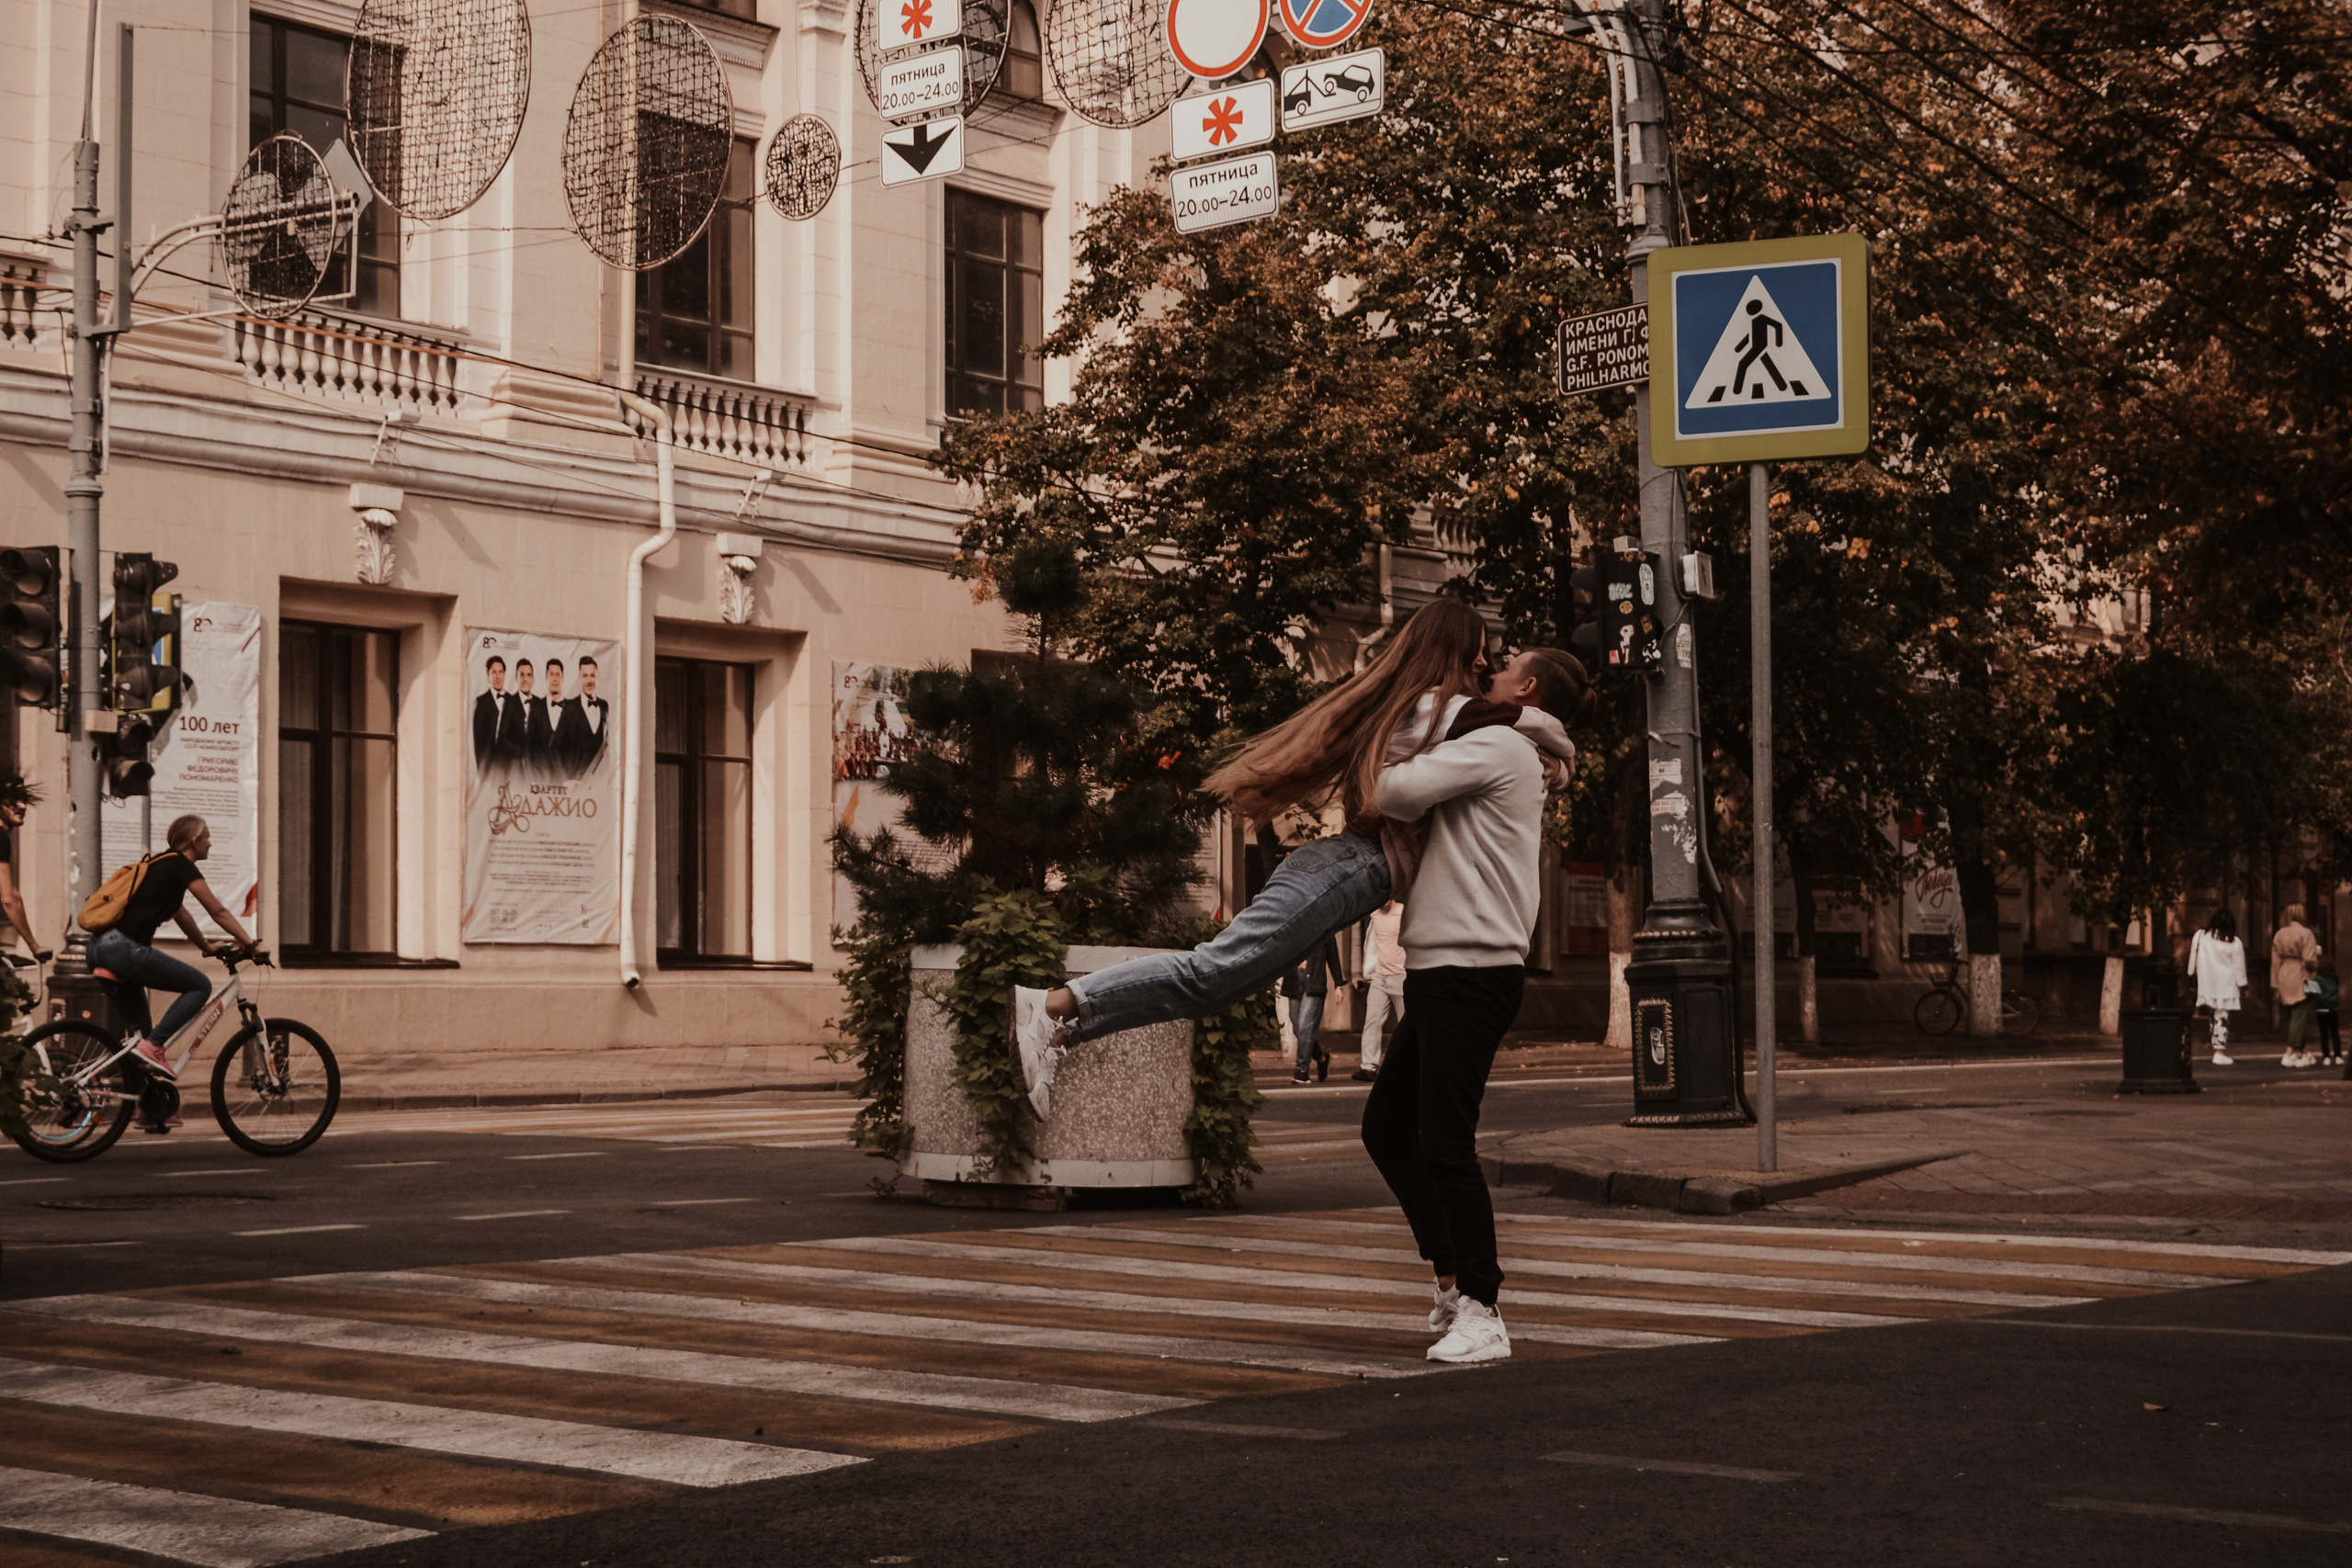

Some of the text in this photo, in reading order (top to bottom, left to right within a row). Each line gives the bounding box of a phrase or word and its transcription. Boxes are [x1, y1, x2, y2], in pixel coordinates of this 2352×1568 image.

[891, 62, 945, 86] пятница
[1189, 163, 1259, 189] пятница
[1566, 308, 1647, 338] КРАСНОДА
[1566, 331, 1617, 355] ИМЕНИ
[1566, 343, 1649, 373] G.F. PONOM
[1566, 360, 1650, 390] PHILHARMO
[179, 716, 241, 735] 100 лет
[198, 756, 239, 766] ГРИГОРИЮ
[179, 773, 239, 784] ПОНОМАРЕНКО
[530, 784, 568, 795] КВАРТЕТ
[488, 781, 597, 835] АДАЖИО
[197, 1008, 222, 1041] STERN
